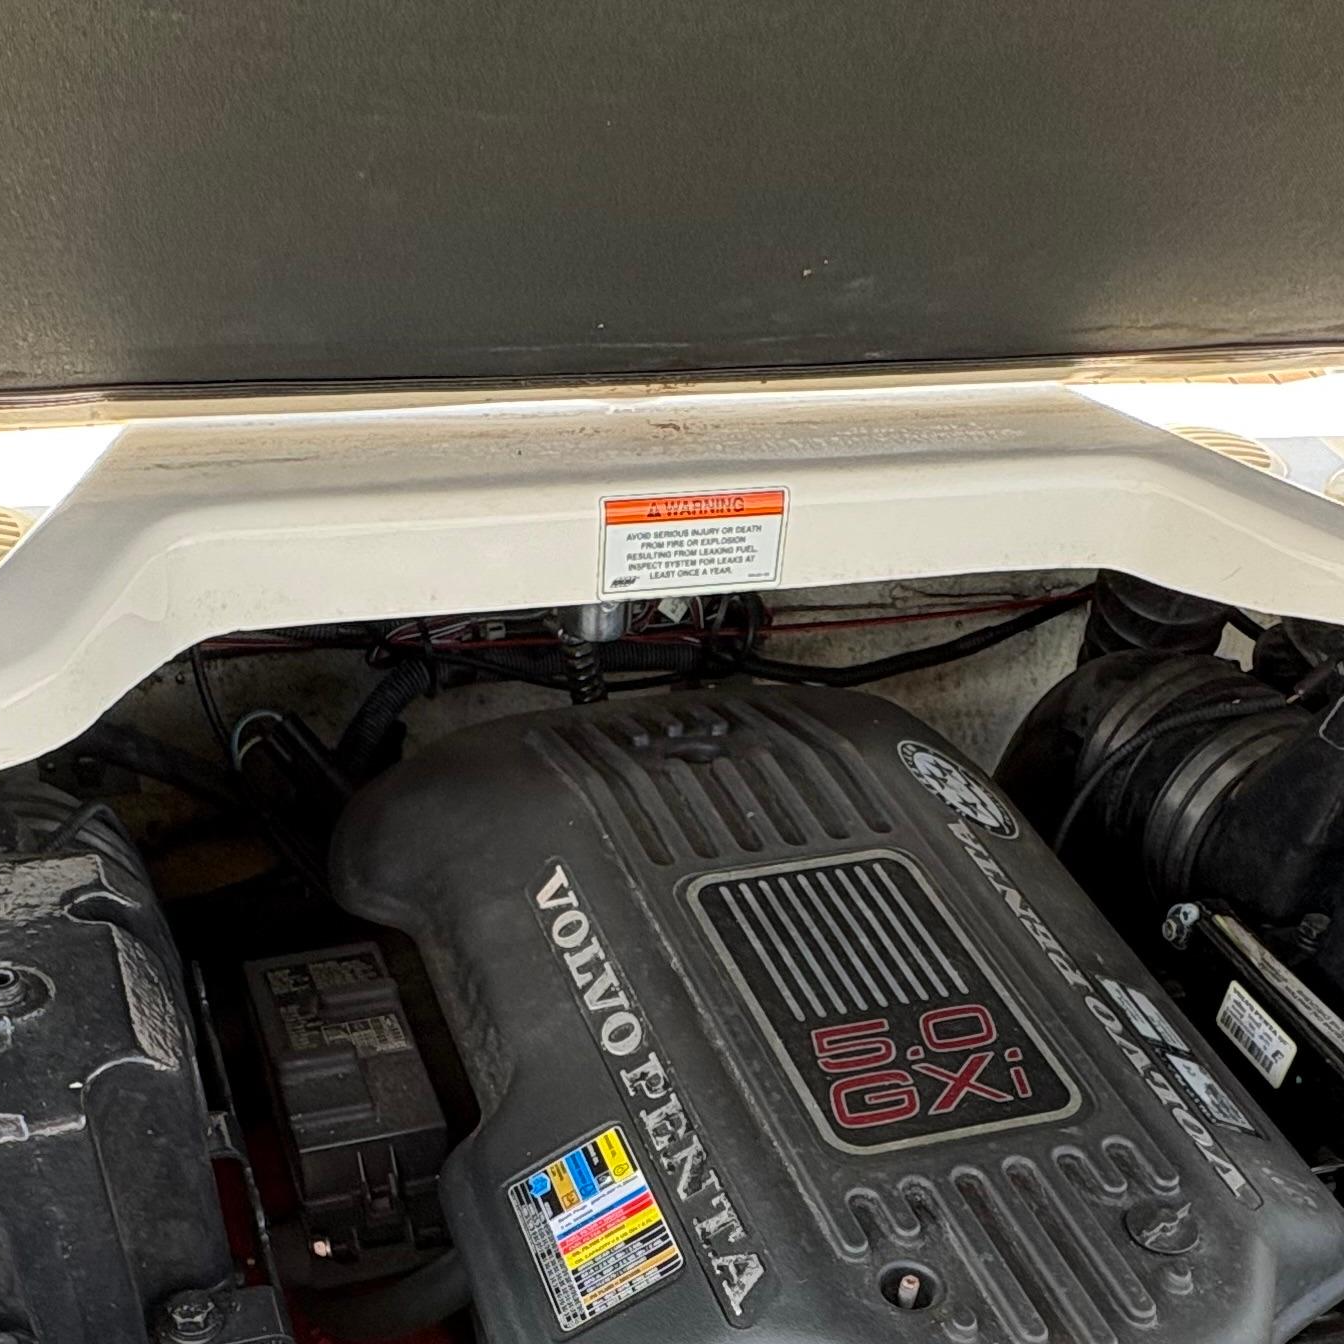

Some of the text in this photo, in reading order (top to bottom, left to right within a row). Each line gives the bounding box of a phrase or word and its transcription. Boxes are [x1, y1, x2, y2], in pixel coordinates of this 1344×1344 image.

[664, 497, 744, 517] WARNING
[626, 524, 762, 541] AVOID SERIOUS INJURY OR DEATH
[640, 535, 746, 550] FROM FIRE OR EXPLOSION
[626, 551, 672, 561] RESULTING
[674, 548, 697, 558] FROM
[699, 546, 734, 556] LEAKING
[628, 554, 756, 571] INSPECT SYSTEM FOR LEAKS AT
[649, 570, 676, 580] LEAST
[676, 568, 700, 578] ONCE
[701, 567, 710, 576] A
[947, 818, 1094, 994] PENTA
[810, 1003, 998, 1074] 5.0
[536, 865, 644, 1057] VOLVO
[619, 1051, 764, 1316] PENTA
[829, 1046, 1032, 1129] GXi
[1084, 995, 1246, 1198] VOLVO
